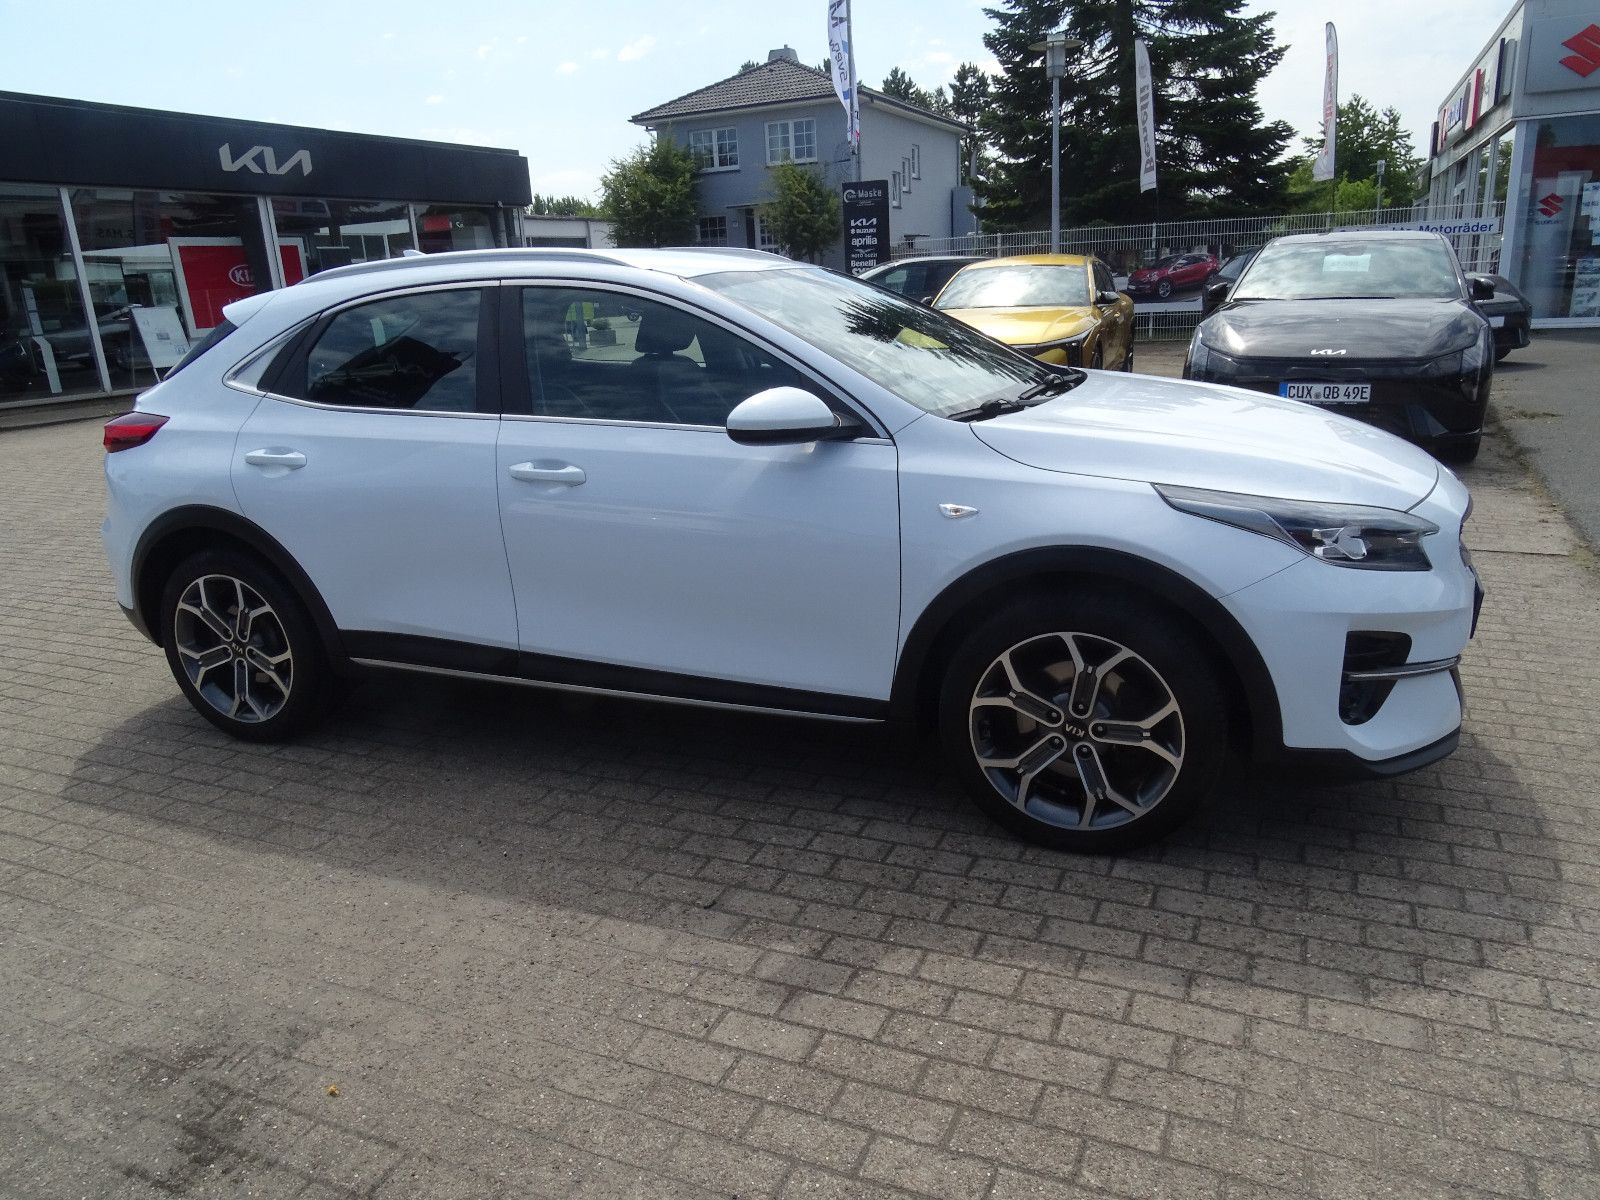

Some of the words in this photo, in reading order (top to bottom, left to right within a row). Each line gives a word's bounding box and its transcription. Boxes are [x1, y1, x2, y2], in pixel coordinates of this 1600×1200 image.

[219, 143, 313, 176] KIA
[851, 218, 877, 227] KIA
[851, 235, 877, 246] aprilia
[851, 260, 876, 268] Benelli
[1288, 385, 1313, 399] CUX
[1323, 386, 1340, 400] QB
[1343, 386, 1369, 400] 49E
[1065, 723, 1085, 738] KIA
